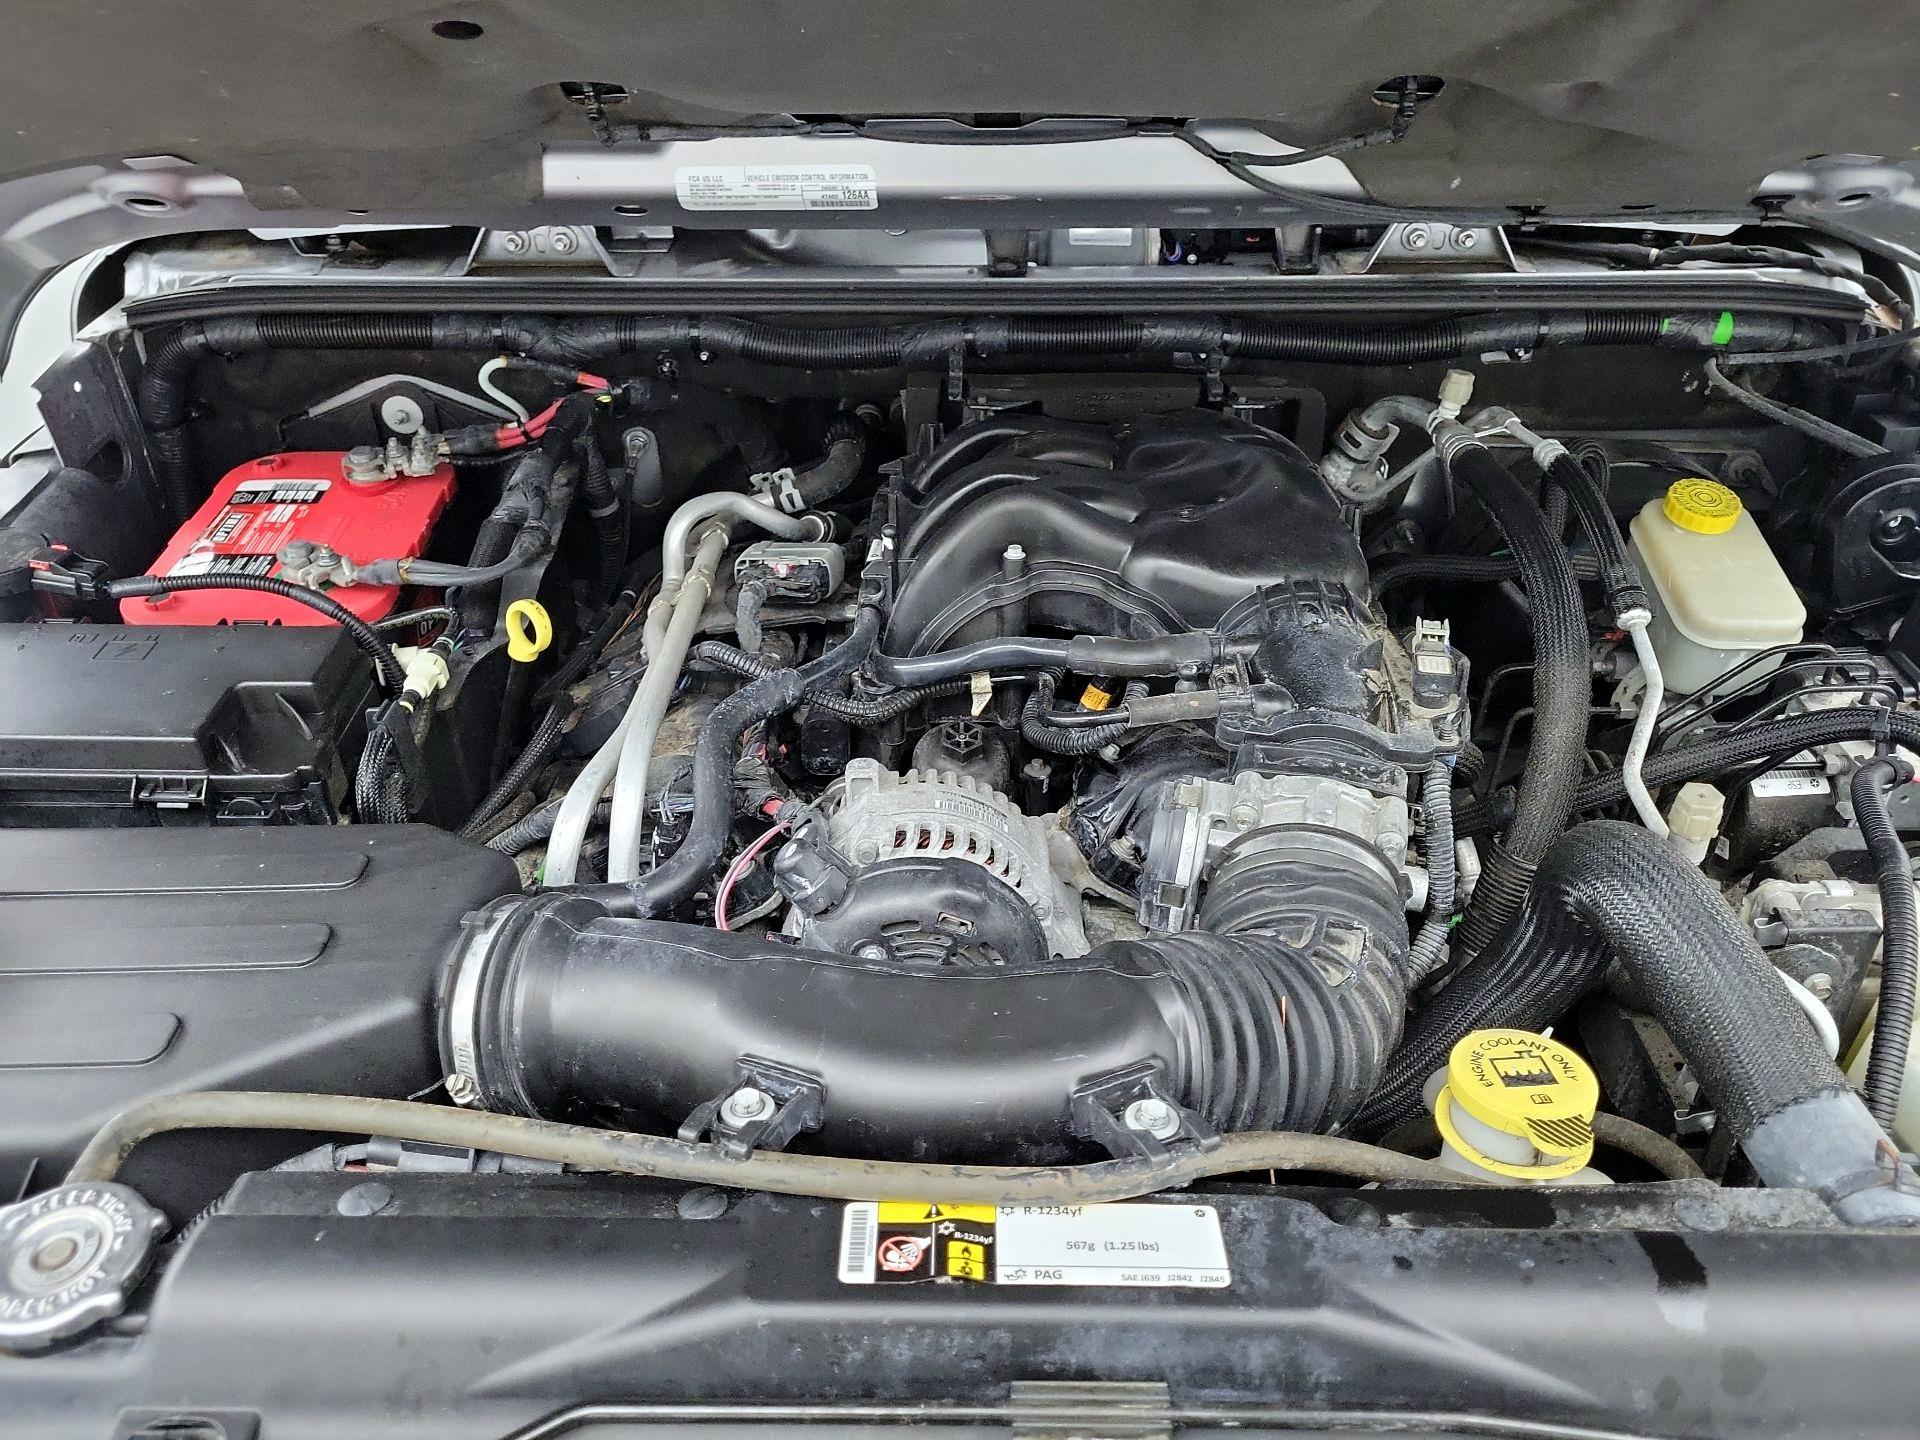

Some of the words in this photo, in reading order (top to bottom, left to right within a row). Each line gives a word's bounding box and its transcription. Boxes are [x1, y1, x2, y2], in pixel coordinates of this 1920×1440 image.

[747, 174, 769, 182] VEHICLE
[842, 190, 869, 200] 126AA
[1480, 1037, 1551, 1052] COOLANT
[1470, 1049, 1495, 1088] ENGINE
[1552, 1053, 1579, 1082] ONLY
[1023, 1206, 1083, 1218] R-1234yf
[953, 1231, 994, 1245] R-1234yf
[1066, 1241, 1096, 1252] 567g
[1104, 1240, 1136, 1252] (1.25
[1138, 1241, 1160, 1253] lbs)
[1034, 1269, 1063, 1280] PAG
[1121, 1273, 1138, 1282] SAE
